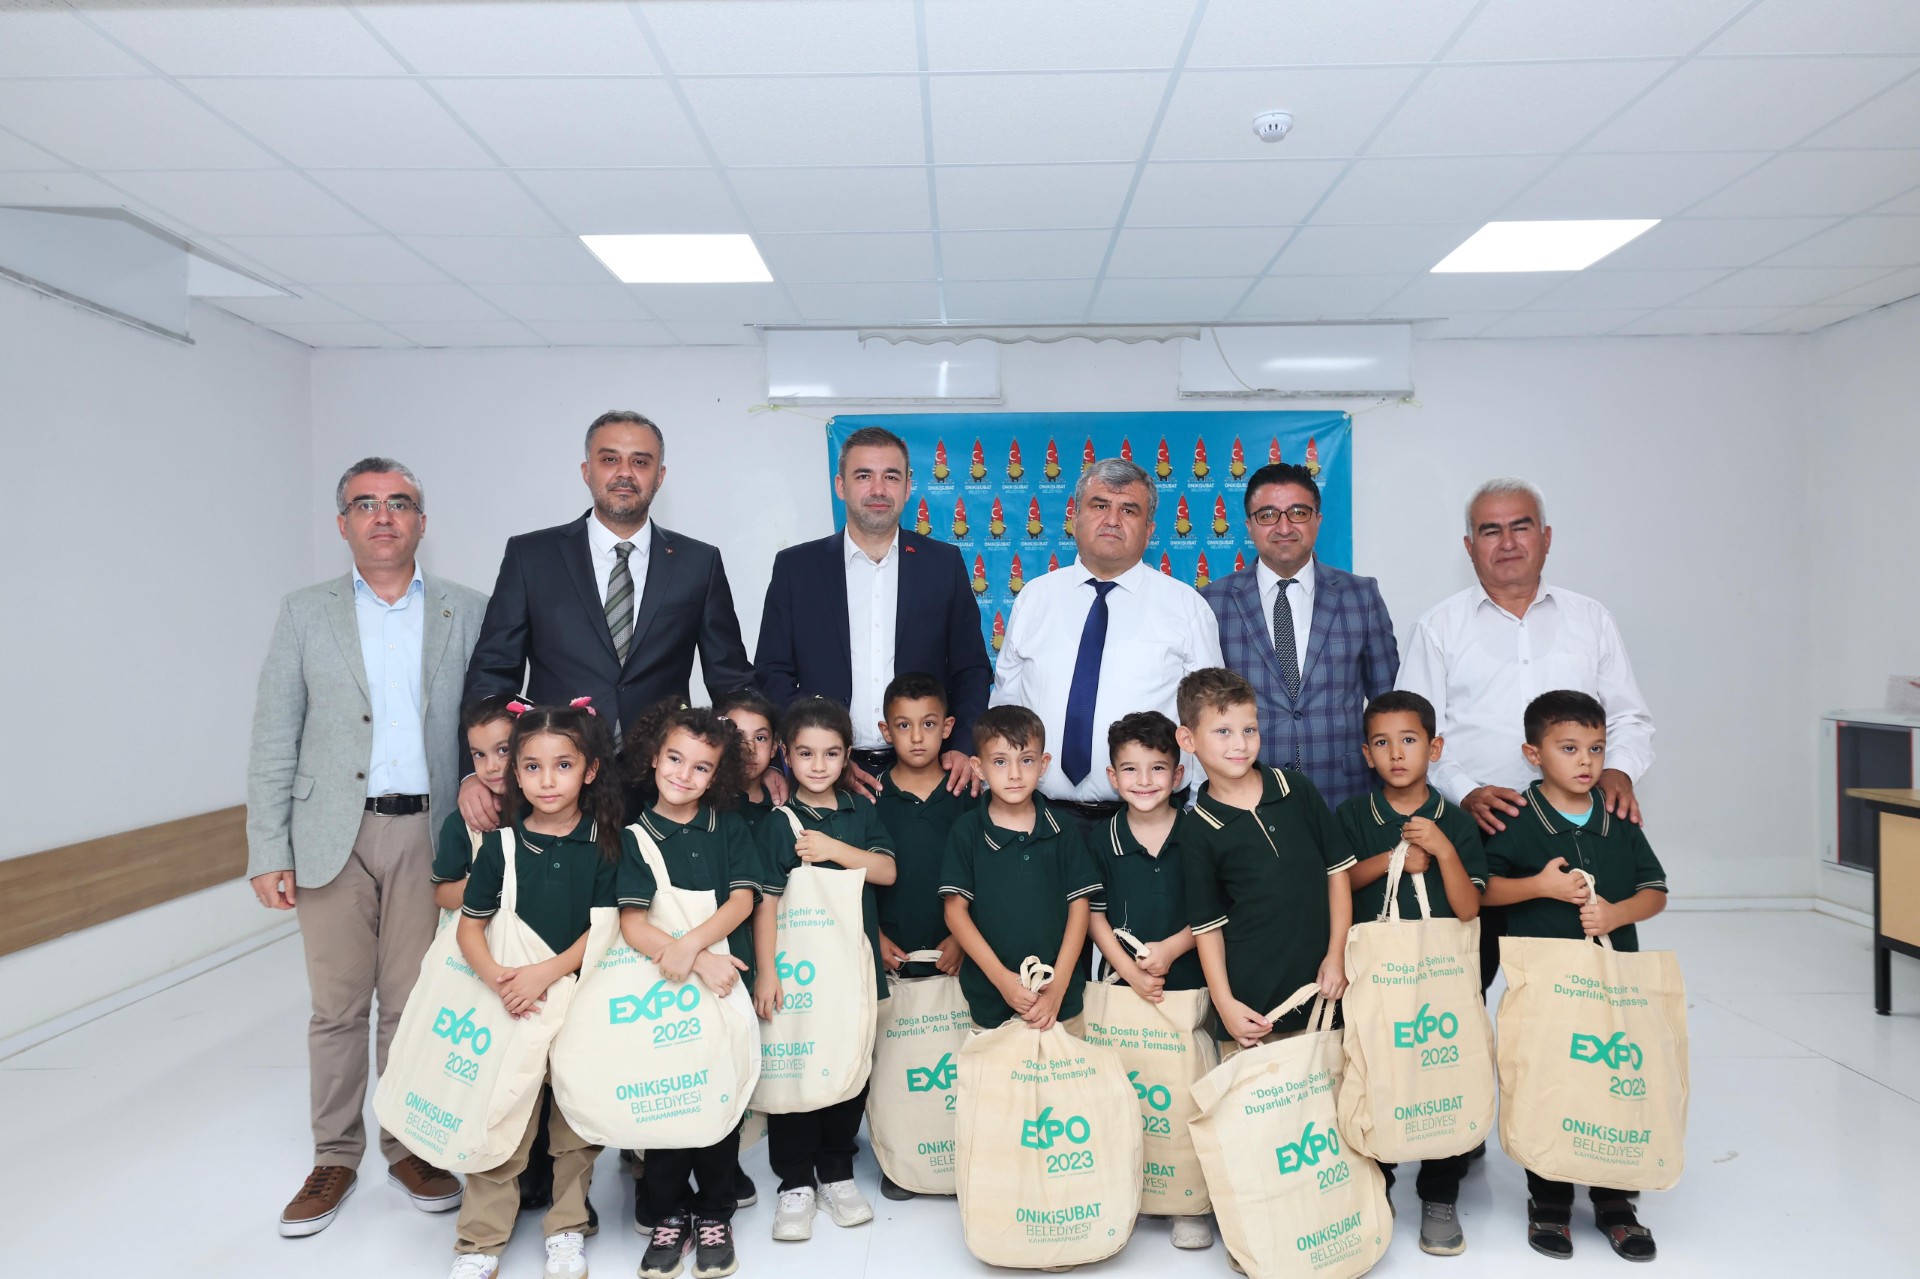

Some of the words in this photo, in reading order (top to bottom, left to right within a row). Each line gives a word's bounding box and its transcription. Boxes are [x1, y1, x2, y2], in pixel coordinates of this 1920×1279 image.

[788, 907, 812, 918] Şehir
[814, 908, 826, 916] ve
[789, 918, 835, 928] Temasıyla
[1425, 955, 1446, 967] Şehir
[1446, 956, 1456, 964] ve
[1428, 966, 1465, 978] Temasıyla
[609, 980, 701, 1024] EXPO
[922, 1013, 948, 1024] Dostu
[950, 1009, 971, 1020] Şehi
[431, 1006, 492, 1056] EXPO
[652, 1016, 702, 1044] 2023
[932, 1024, 950, 1033] Ana
[1110, 1026, 1139, 1036] Dostu
[1142, 1028, 1168, 1039] Şehir
[1120, 1039, 1139, 1048] Ana
[1049, 1058, 1072, 1071] Şehir
[1074, 1057, 1086, 1065] ve
[1420, 1045, 1460, 1068] 2023
[444, 1051, 480, 1082] 2023
[906, 1052, 958, 1092] EXP
[1051, 1066, 1096, 1081] Temasıyla
[1609, 1076, 1647, 1097] 2023
[1275, 1121, 1340, 1176] EXPO
[1046, 1150, 1095, 1174] 2023
[1316, 1161, 1350, 1190] 2023
